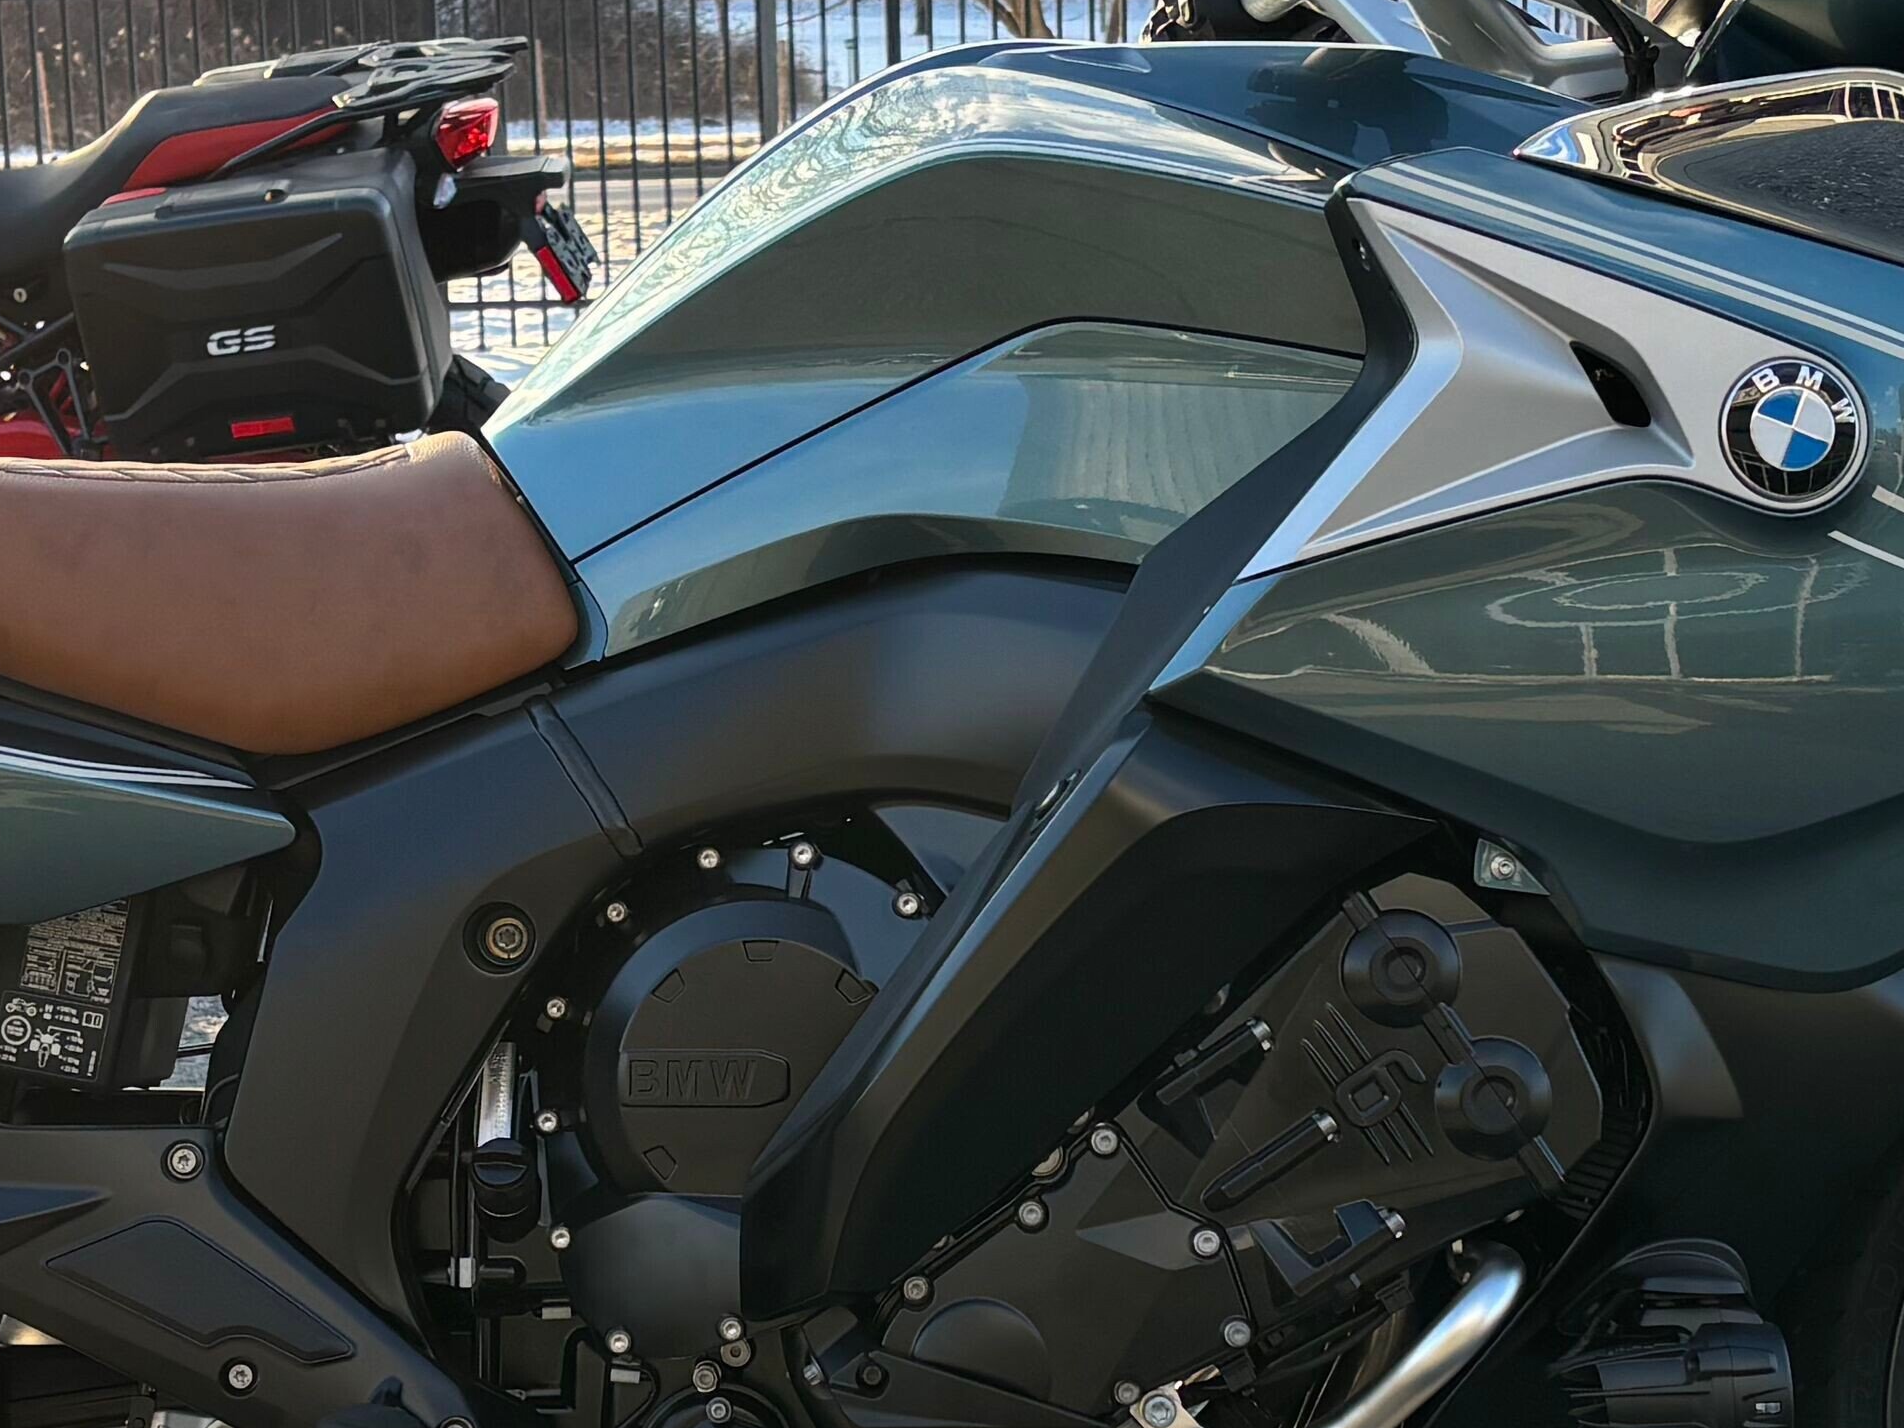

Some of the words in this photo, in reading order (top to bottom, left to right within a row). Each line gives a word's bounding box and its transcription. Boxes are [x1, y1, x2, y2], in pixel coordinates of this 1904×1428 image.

[207, 324, 276, 357] GS
[1751, 364, 1856, 424] BMW
[628, 1058, 759, 1100] BMW
